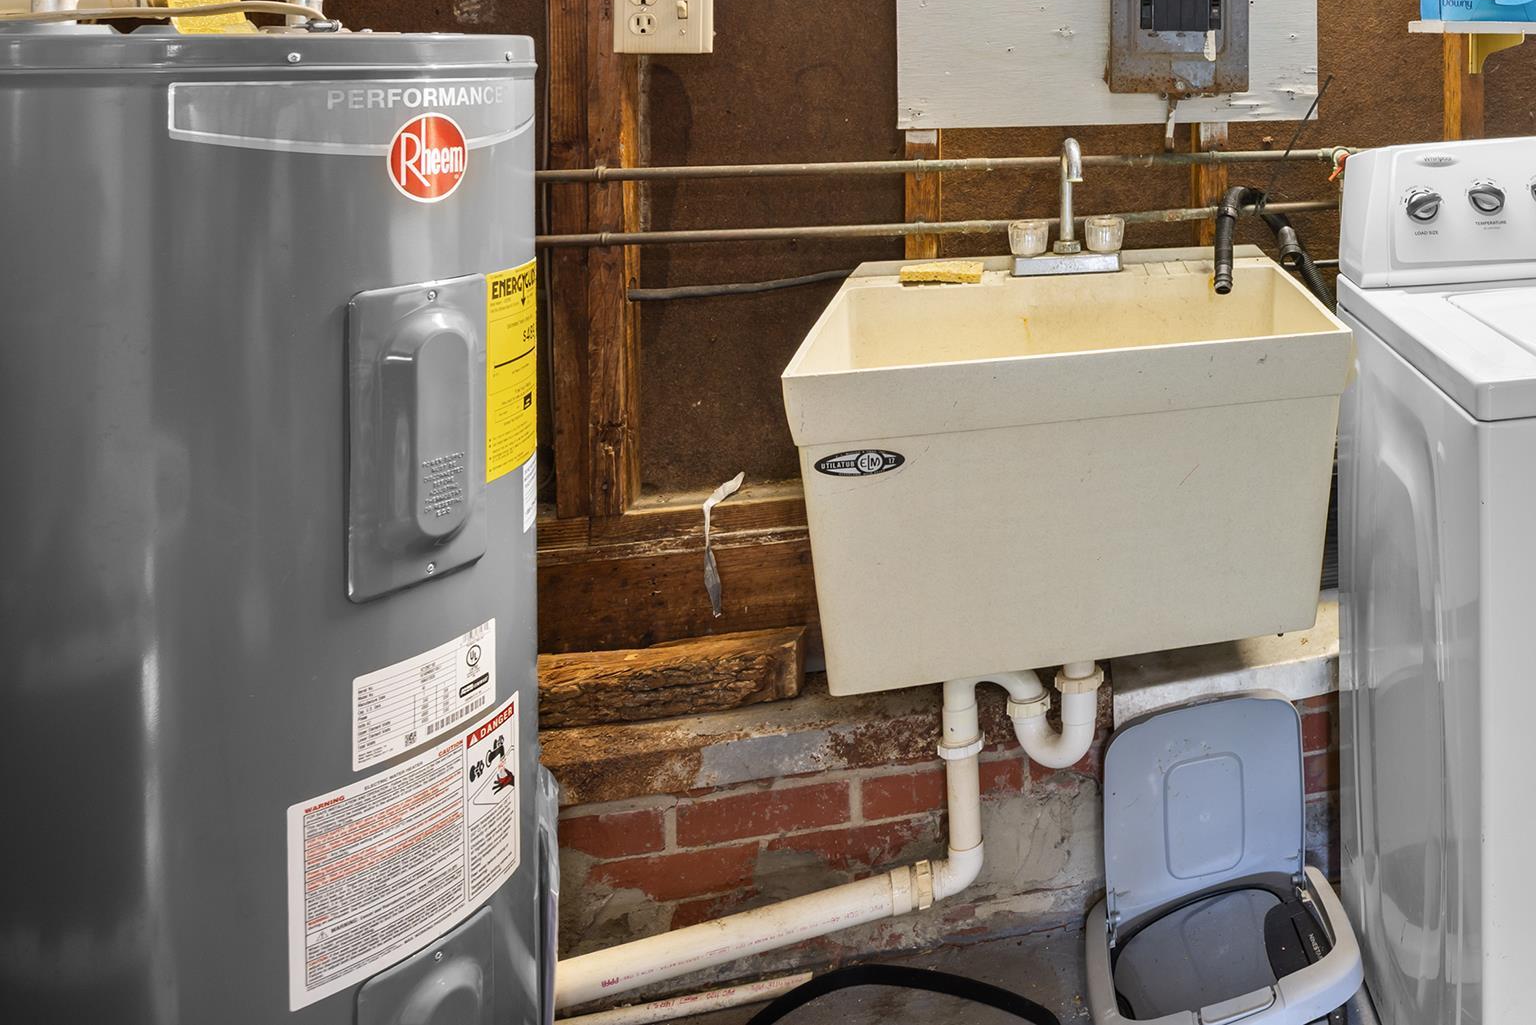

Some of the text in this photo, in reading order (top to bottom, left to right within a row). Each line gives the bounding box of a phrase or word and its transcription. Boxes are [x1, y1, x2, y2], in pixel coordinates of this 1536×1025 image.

[327, 85, 503, 109] PERFORMANCE
[400, 118, 463, 186] Rheem
[480, 705, 513, 737] DANGER
[438, 740, 464, 757] CAUTION
[304, 795, 346, 814] WARNING
